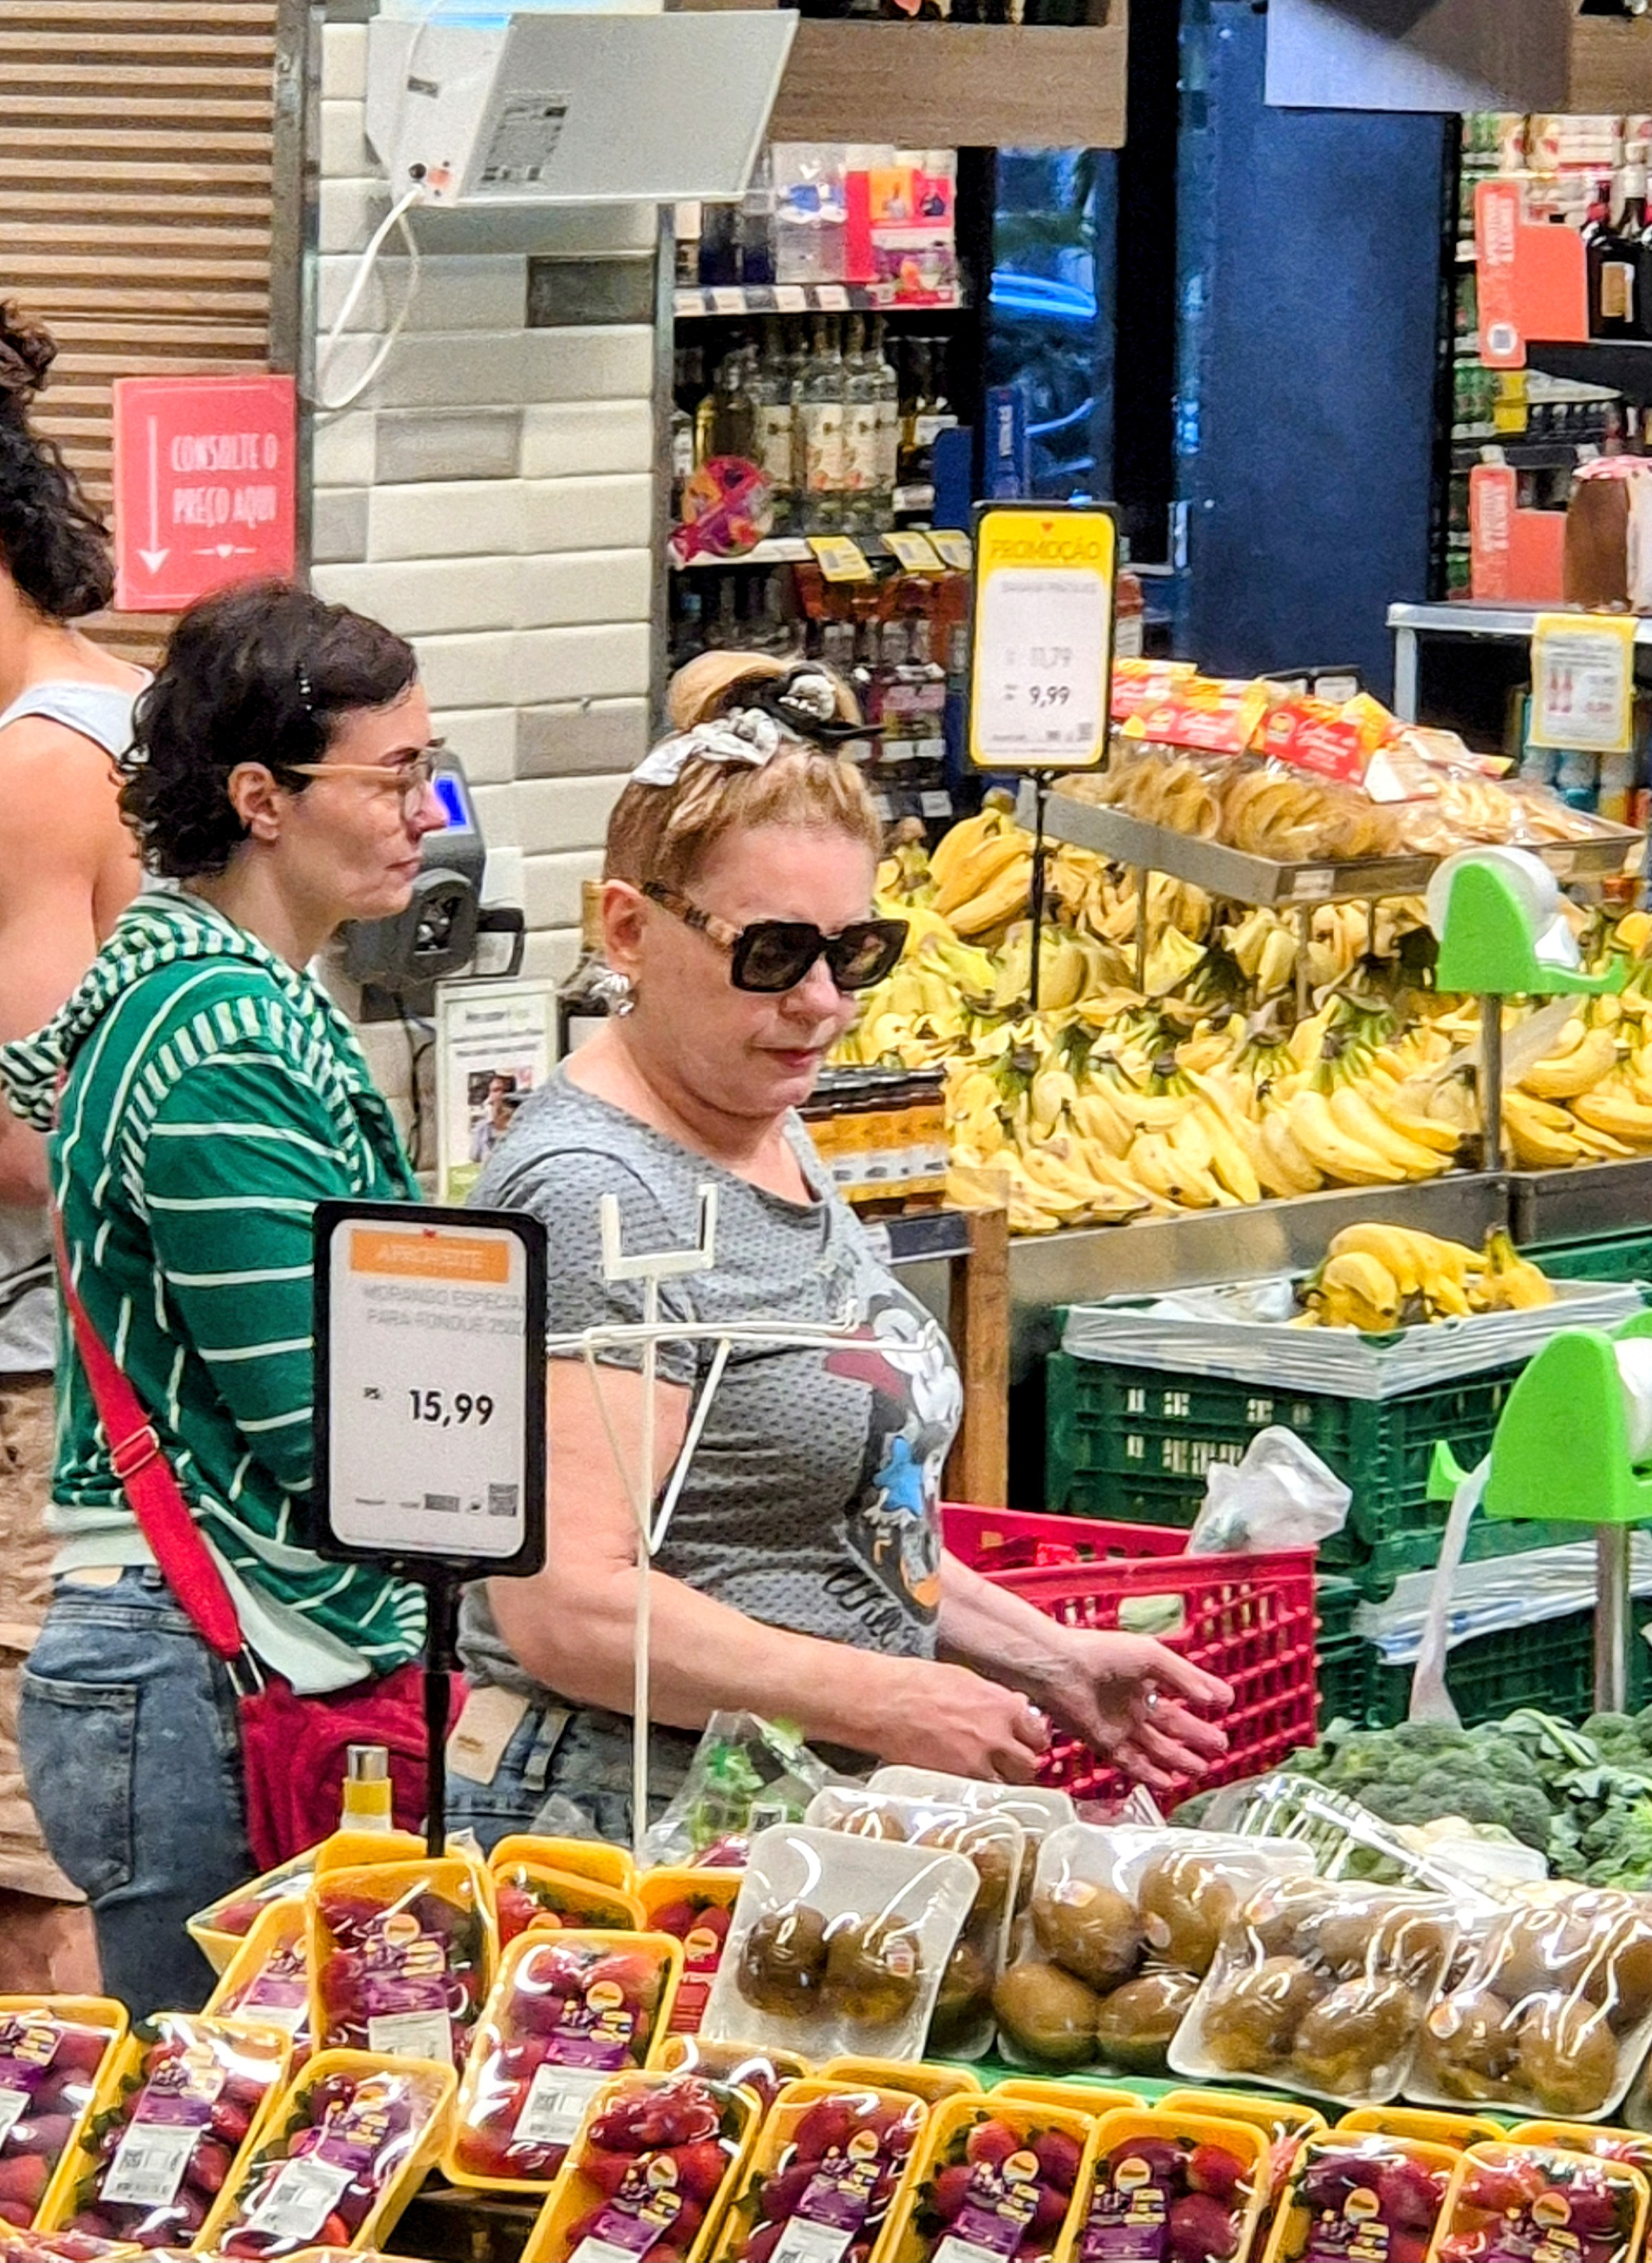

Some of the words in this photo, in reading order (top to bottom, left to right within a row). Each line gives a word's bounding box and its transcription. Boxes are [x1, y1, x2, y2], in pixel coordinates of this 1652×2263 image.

[172, 433, 260, 472] CONSULTE
[264, 433, 279, 470] O
[172, 487, 231, 529] PREÇO
[233, 485, 277, 530] AQUI
[989, 536, 1101, 561] PROMOÇÃO
[1029, 685, 1070, 708] 9,99
[409, 1389, 494, 1428] 15,99
